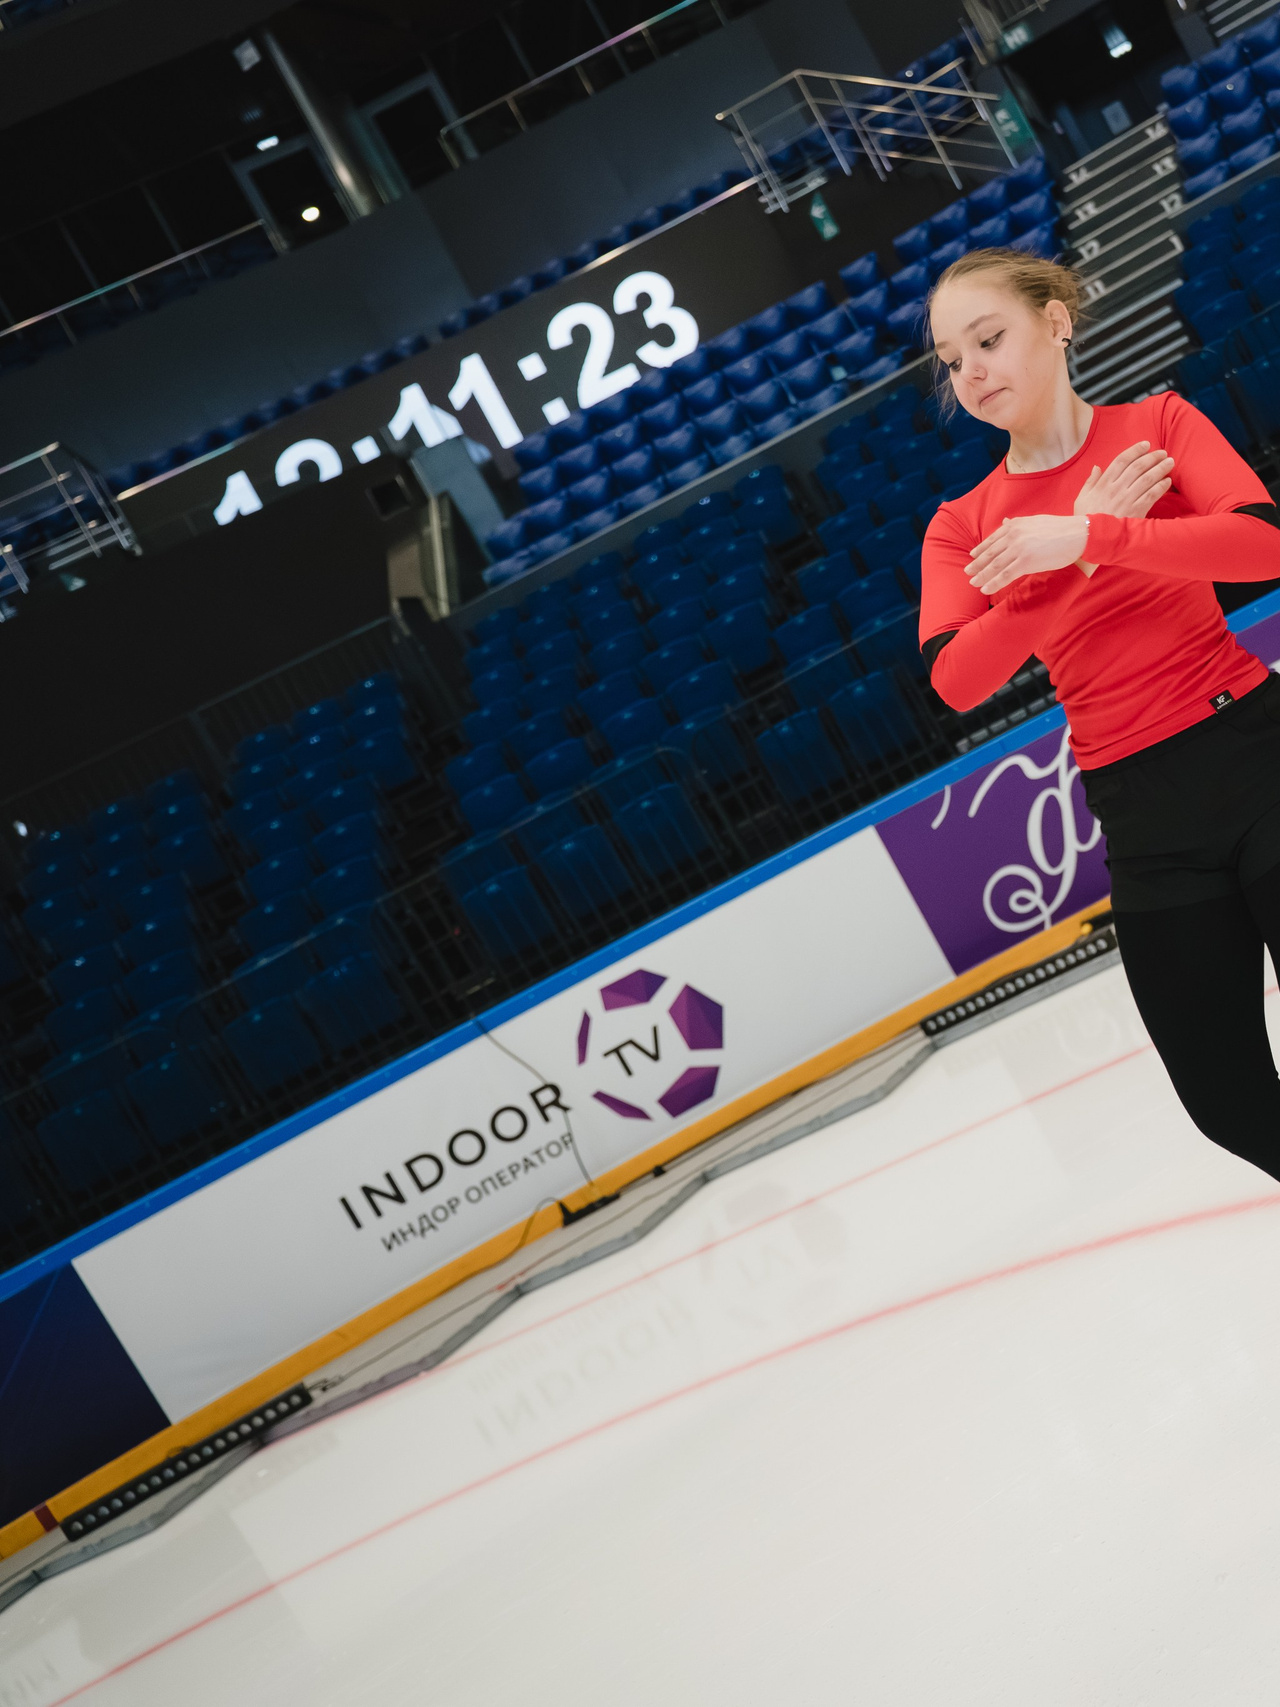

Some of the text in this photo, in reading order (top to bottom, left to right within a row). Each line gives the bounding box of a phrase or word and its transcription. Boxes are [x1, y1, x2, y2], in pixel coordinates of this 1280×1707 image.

[603, 1025, 661, 1077] TV
[340, 1083, 571, 1230] INDOOR
[381, 1132, 574, 1252] ИНДОР ОПЕРАТОР
